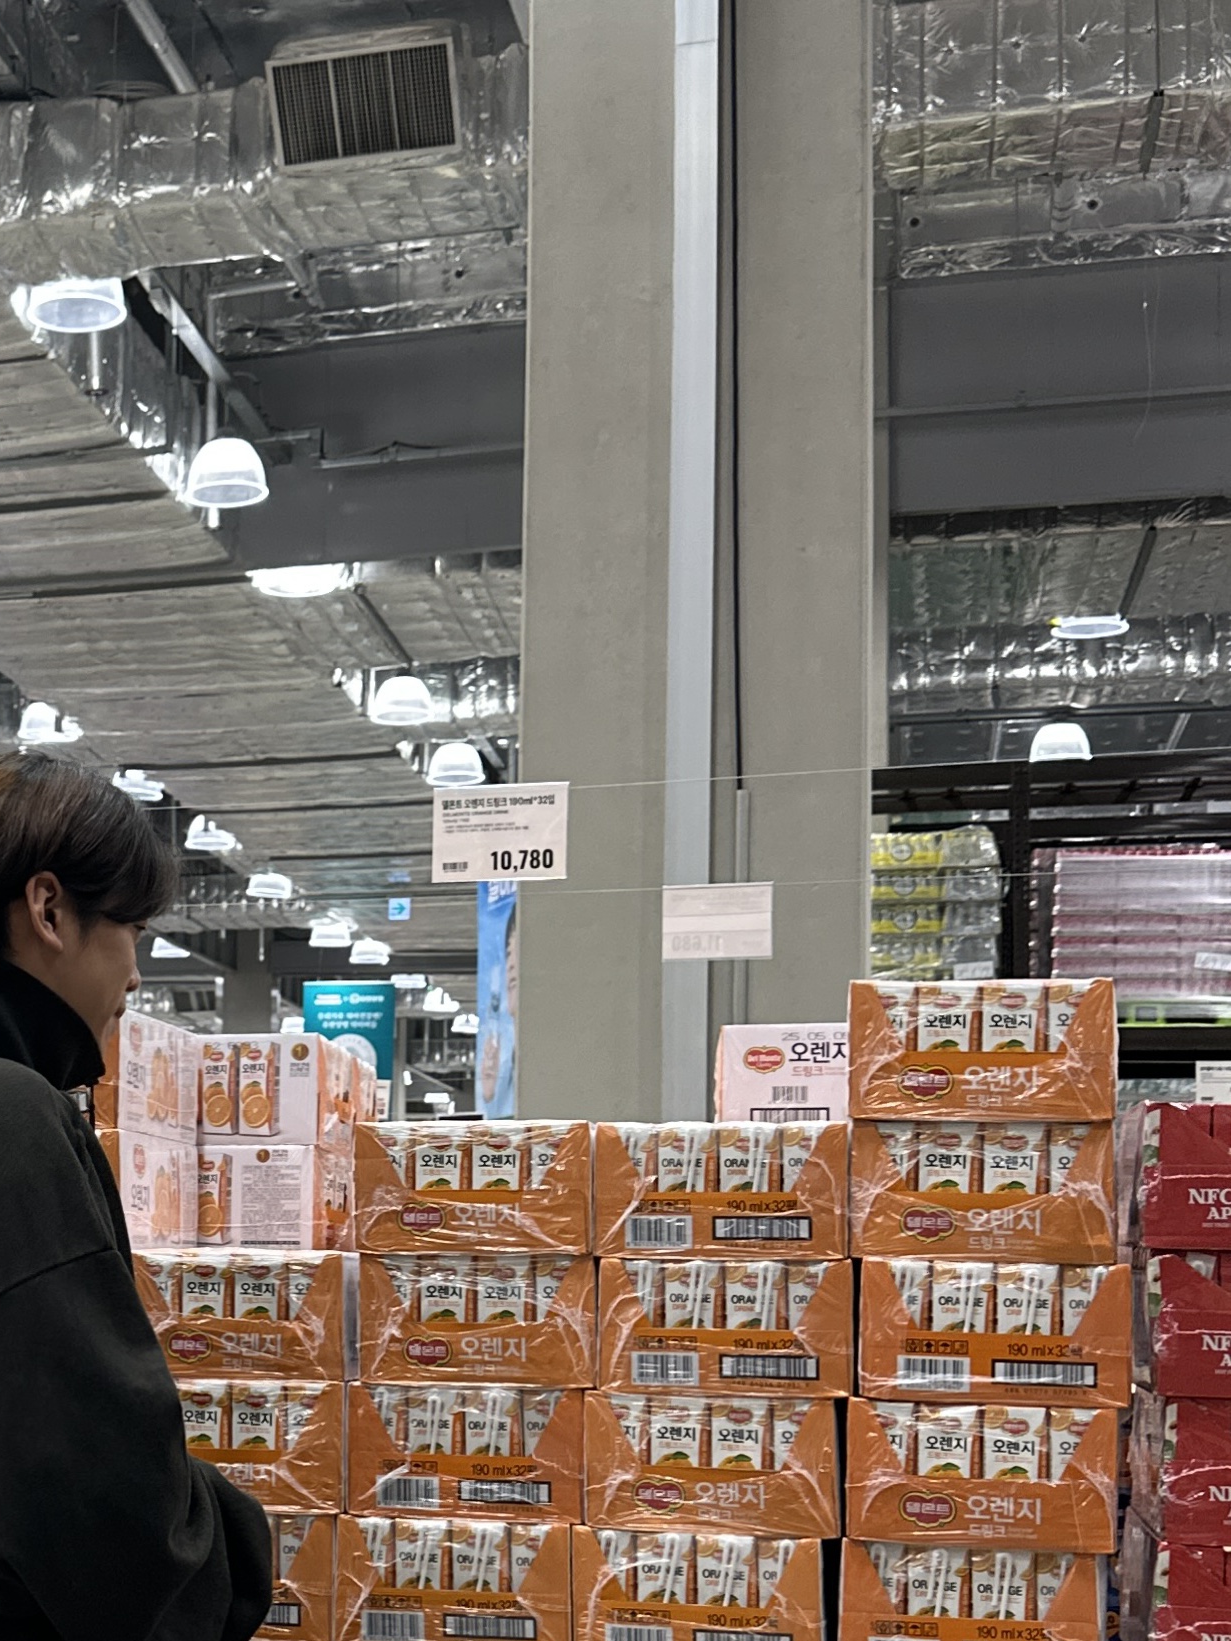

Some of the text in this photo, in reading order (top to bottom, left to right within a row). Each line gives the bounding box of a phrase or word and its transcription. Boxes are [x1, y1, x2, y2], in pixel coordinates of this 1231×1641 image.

[491, 849, 553, 873] 10,780
[924, 1014, 966, 1029] 오렌지
[242, 1064, 265, 1074] 오렌지
[961, 1066, 1040, 1090] 오렌지
[420, 1154, 457, 1168] 오렌지
[454, 1203, 519, 1226] 오렌지
[964, 1209, 1041, 1235] 오렌지
[220, 1332, 282, 1357] 오렌지
[459, 1337, 527, 1361] 오렌지
[694, 1482, 766, 1509] 오렌지
[965, 1496, 1042, 1524] 오렌지
